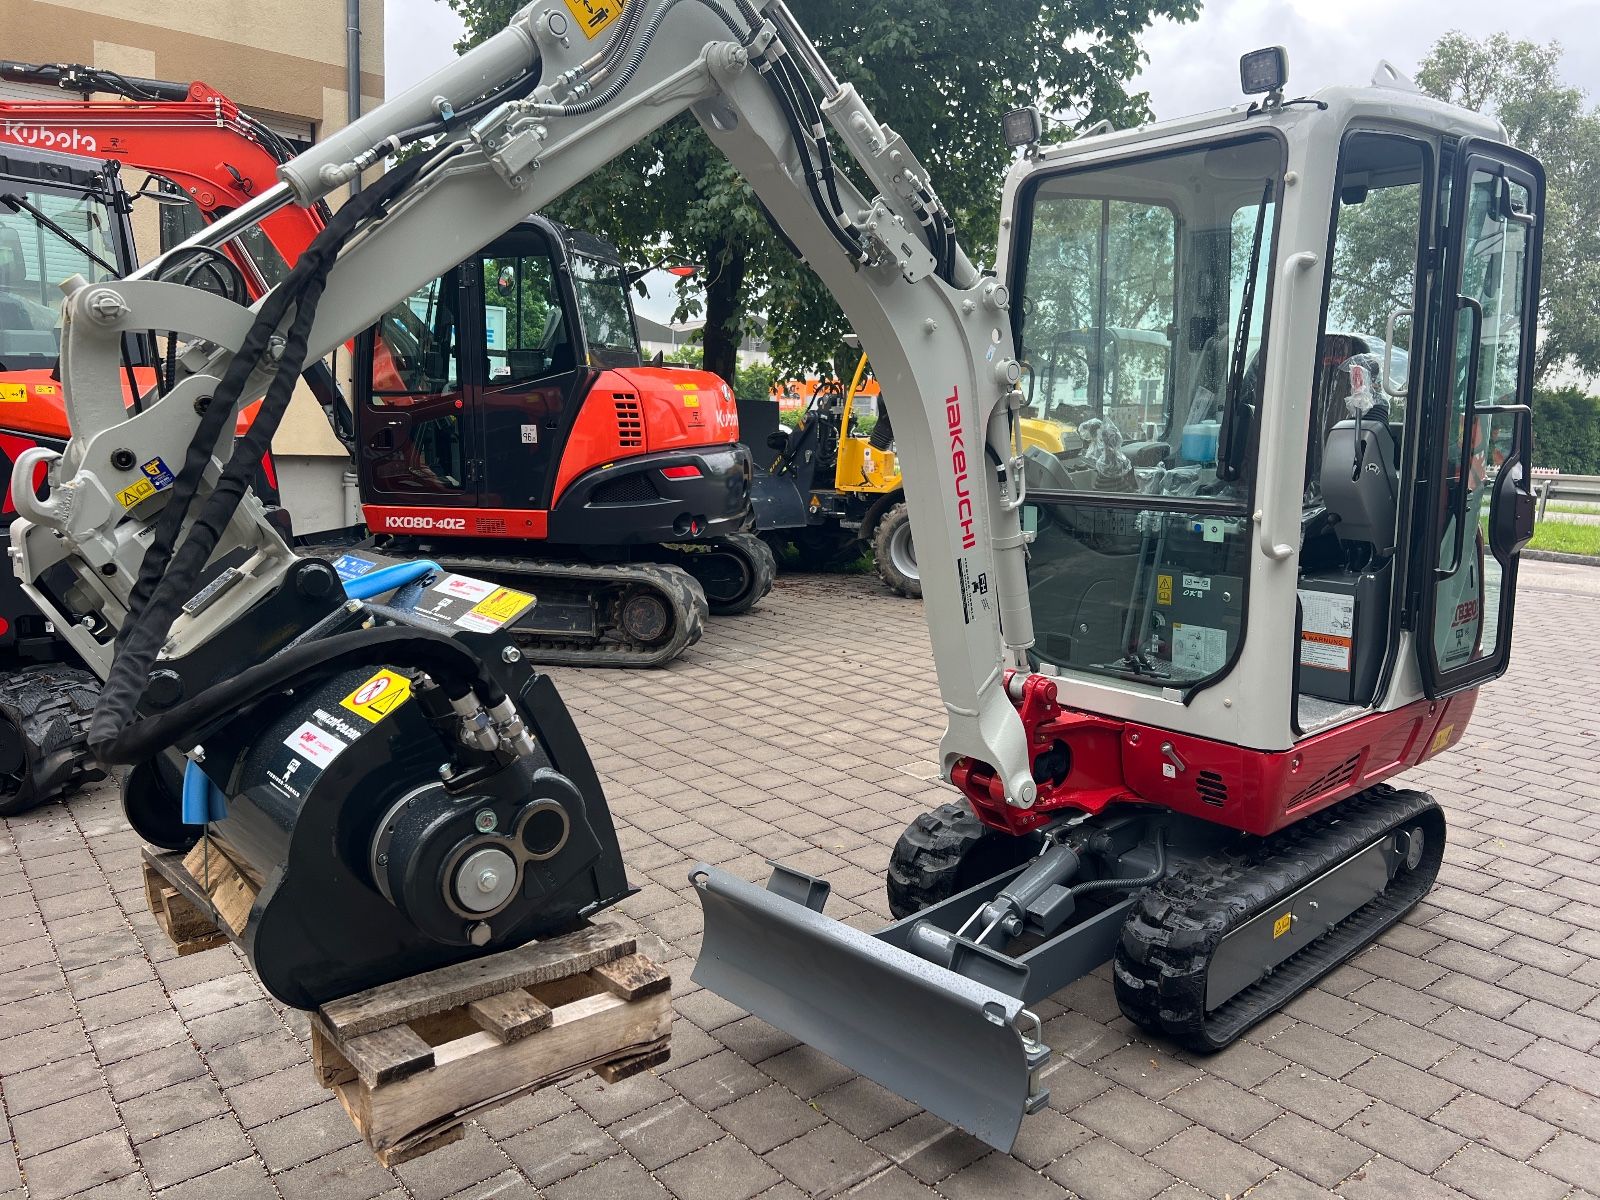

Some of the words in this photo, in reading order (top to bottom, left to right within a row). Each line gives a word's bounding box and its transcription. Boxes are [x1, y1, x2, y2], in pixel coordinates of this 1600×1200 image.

[5, 120, 97, 152] Kubota
[945, 384, 976, 550] TAKEUCHI
[1308, 635, 1344, 647] WARNUNG
